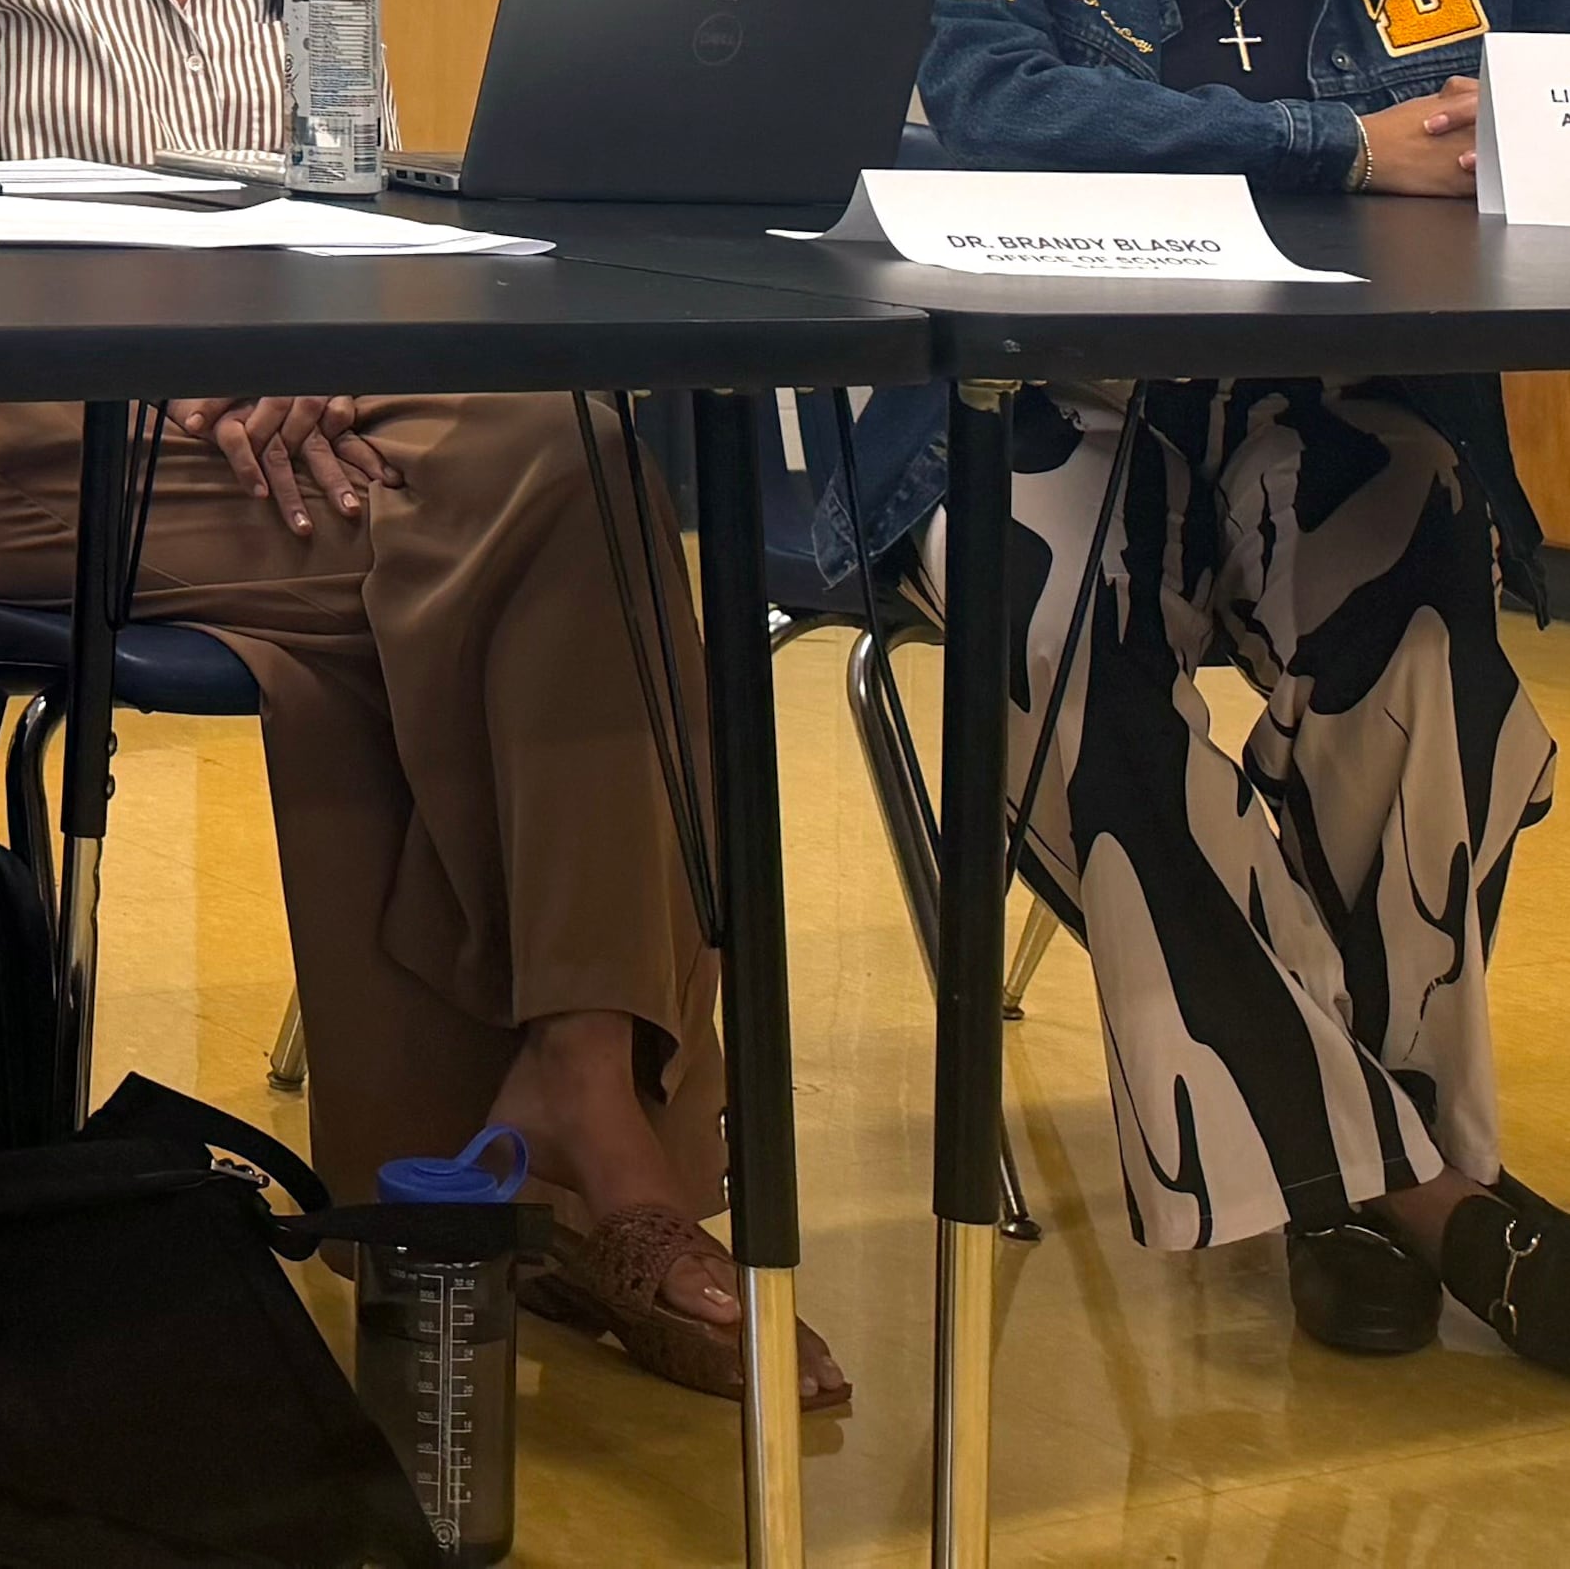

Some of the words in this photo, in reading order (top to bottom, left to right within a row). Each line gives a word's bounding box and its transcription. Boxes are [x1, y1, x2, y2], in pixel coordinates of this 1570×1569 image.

[947, 235, 994, 249] DR.
[998, 236, 1107, 251] BRANDY
[1113, 238, 1222, 253] BLASKO
[986, 254, 1073, 263] OFFICE
[1077, 255, 1108, 263] OF
[1115, 256, 1218, 266] SCHOOL
